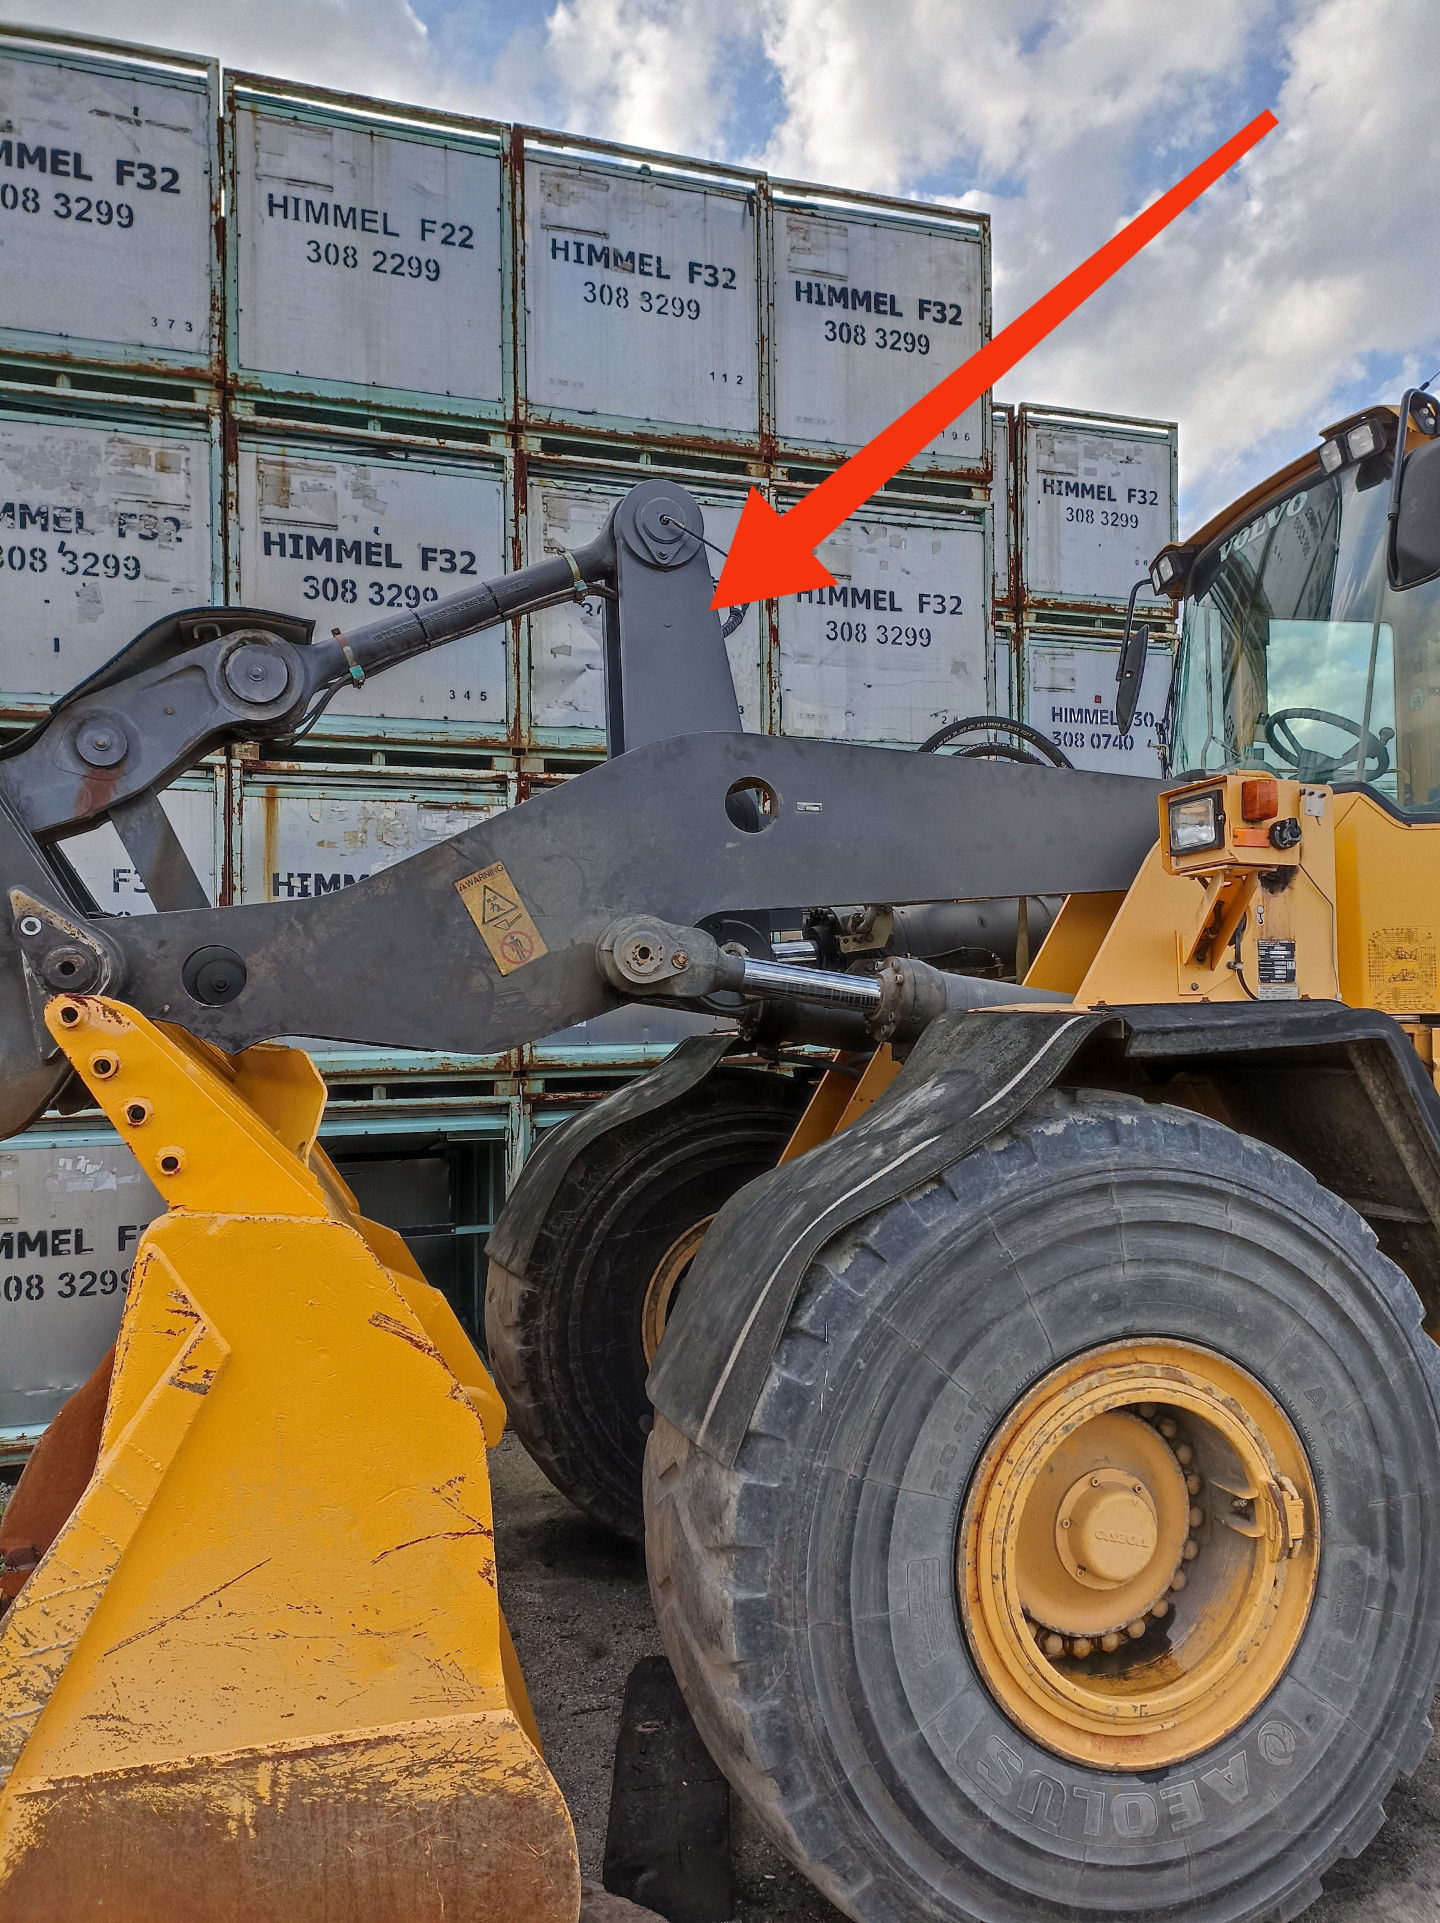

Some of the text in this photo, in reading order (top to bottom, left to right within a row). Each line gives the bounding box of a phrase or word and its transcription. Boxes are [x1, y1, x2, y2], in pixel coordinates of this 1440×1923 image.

[116, 159, 180, 194] F32
[1, 184, 133, 228] 08 3299
[268, 194, 473, 249] HIMMEL F22
[307, 240, 440, 281] 308 2299
[551, 238, 736, 290] HIMMEL F32
[584, 282, 700, 320] 308 3299
[795, 280, 962, 325] HIMMEL F32
[825, 321, 929, 355] 308 3299
[1042, 478, 1158, 505] HIMMEL F32
[115, 508, 186, 542] F32
[1066, 507, 1138, 528] 308 3299
[1218, 491, 1308, 563] VOLVO
[0, 544, 142, 582] 08 3299
[263, 531, 477, 574] HIMMEL F32
[304, 576, 439, 609] 308 3299
[797, 586, 962, 615] HIMMEL F32
[826, 621, 931, 647] 308 3299
[1051, 706, 1118, 726] HIMMEL
[1052, 731, 1085, 748] 308
[1090, 733, 1135, 751] 0740
[466, 864, 504, 888] WARNING
[118, 1224, 149, 1251] F
[1273, 1383, 1285, 1396] ALL
[1301, 1422, 1317, 1452] RADIAL
[975, 1734, 1250, 1838] AEOLUS
